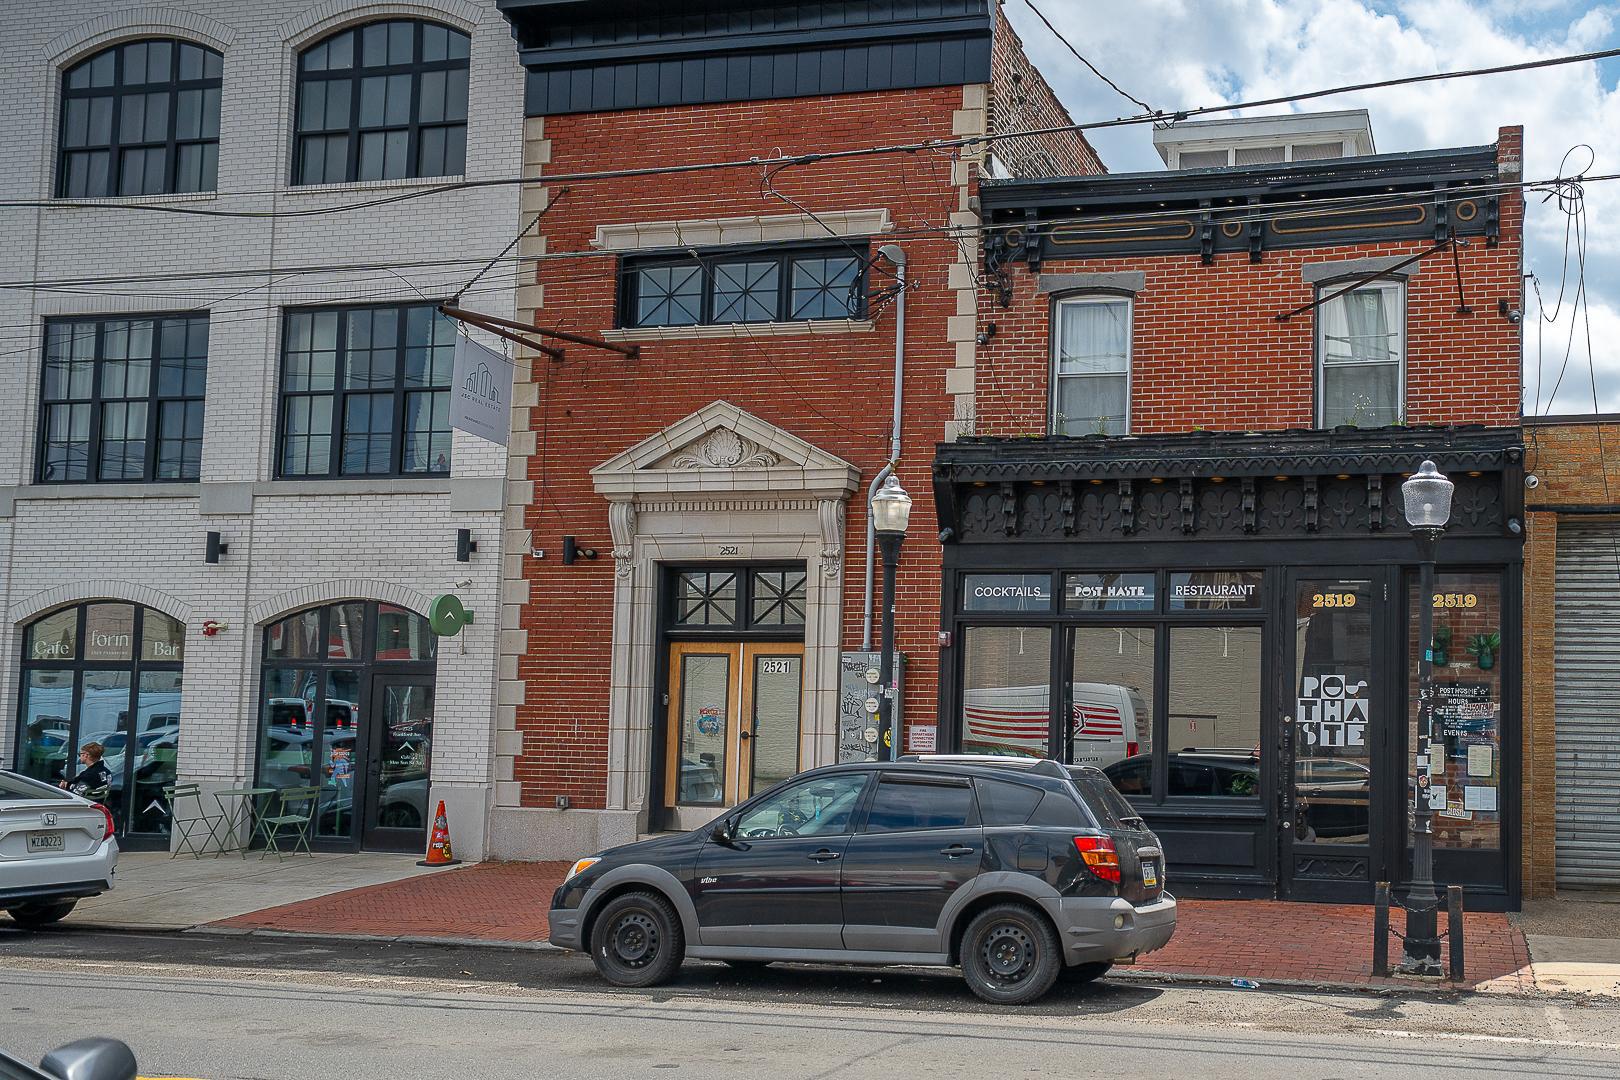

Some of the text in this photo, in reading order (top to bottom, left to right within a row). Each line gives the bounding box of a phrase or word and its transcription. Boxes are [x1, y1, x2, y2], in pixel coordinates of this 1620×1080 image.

[472, 397, 484, 405] REAL
[485, 403, 502, 412] ESTATE
[720, 546, 739, 555] 2521
[974, 586, 1041, 597] COCKTAILS
[1075, 586, 1145, 597] POST HASTE
[1175, 584, 1256, 596] RESTAURANT
[1312, 593, 1356, 608] 2519
[1432, 593, 1477, 608] 2519
[34, 640, 70, 655] Cafe
[154, 641, 180, 656] Bar
[764, 661, 789, 673] 2521
[1446, 806, 1466, 817] CLOSED
